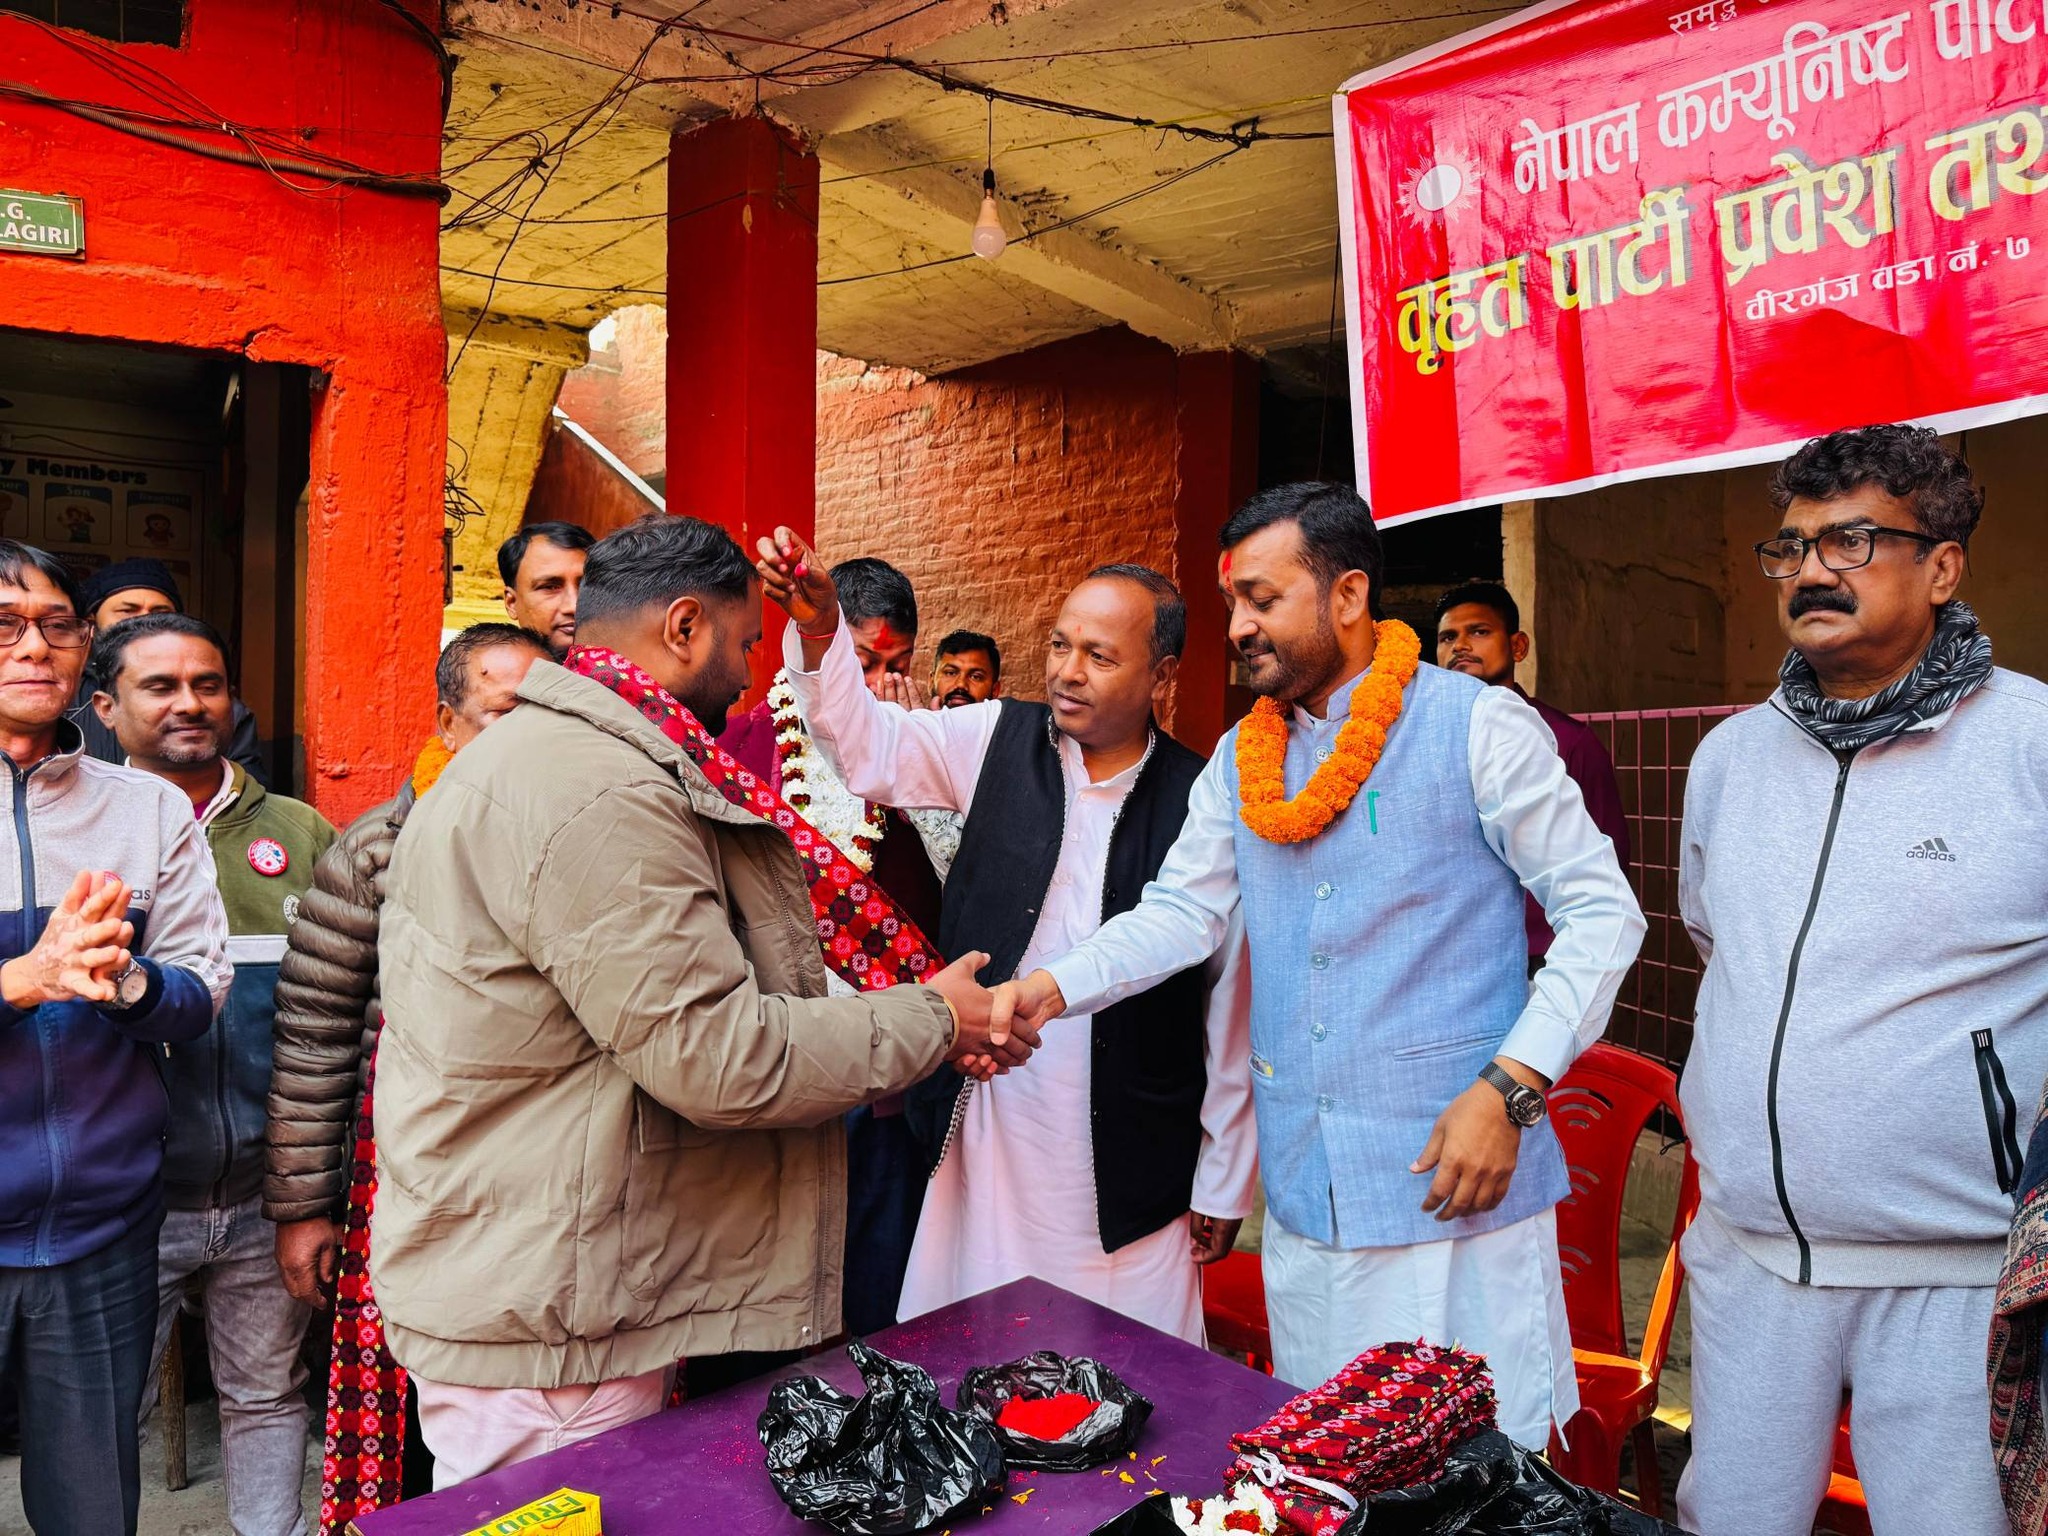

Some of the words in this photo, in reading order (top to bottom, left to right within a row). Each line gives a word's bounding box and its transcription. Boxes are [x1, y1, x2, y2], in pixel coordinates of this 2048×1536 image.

[1511, 102, 1642, 195] नेपाल
[1656, 11, 1912, 150] कम्यूनिष्ट
[1929, 0, 2048, 61] पाट
[1396, 255, 1528, 376] वृहत
[1546, 187, 1691, 312] पार्टी
[1714, 150, 1898, 288] प्रवेश
[1745, 274, 1861, 321] वीरगंज
[1871, 255, 1935, 291] वडा
[26, 458, 148, 485] Members
[1905, 849, 1957, 862] adidas
